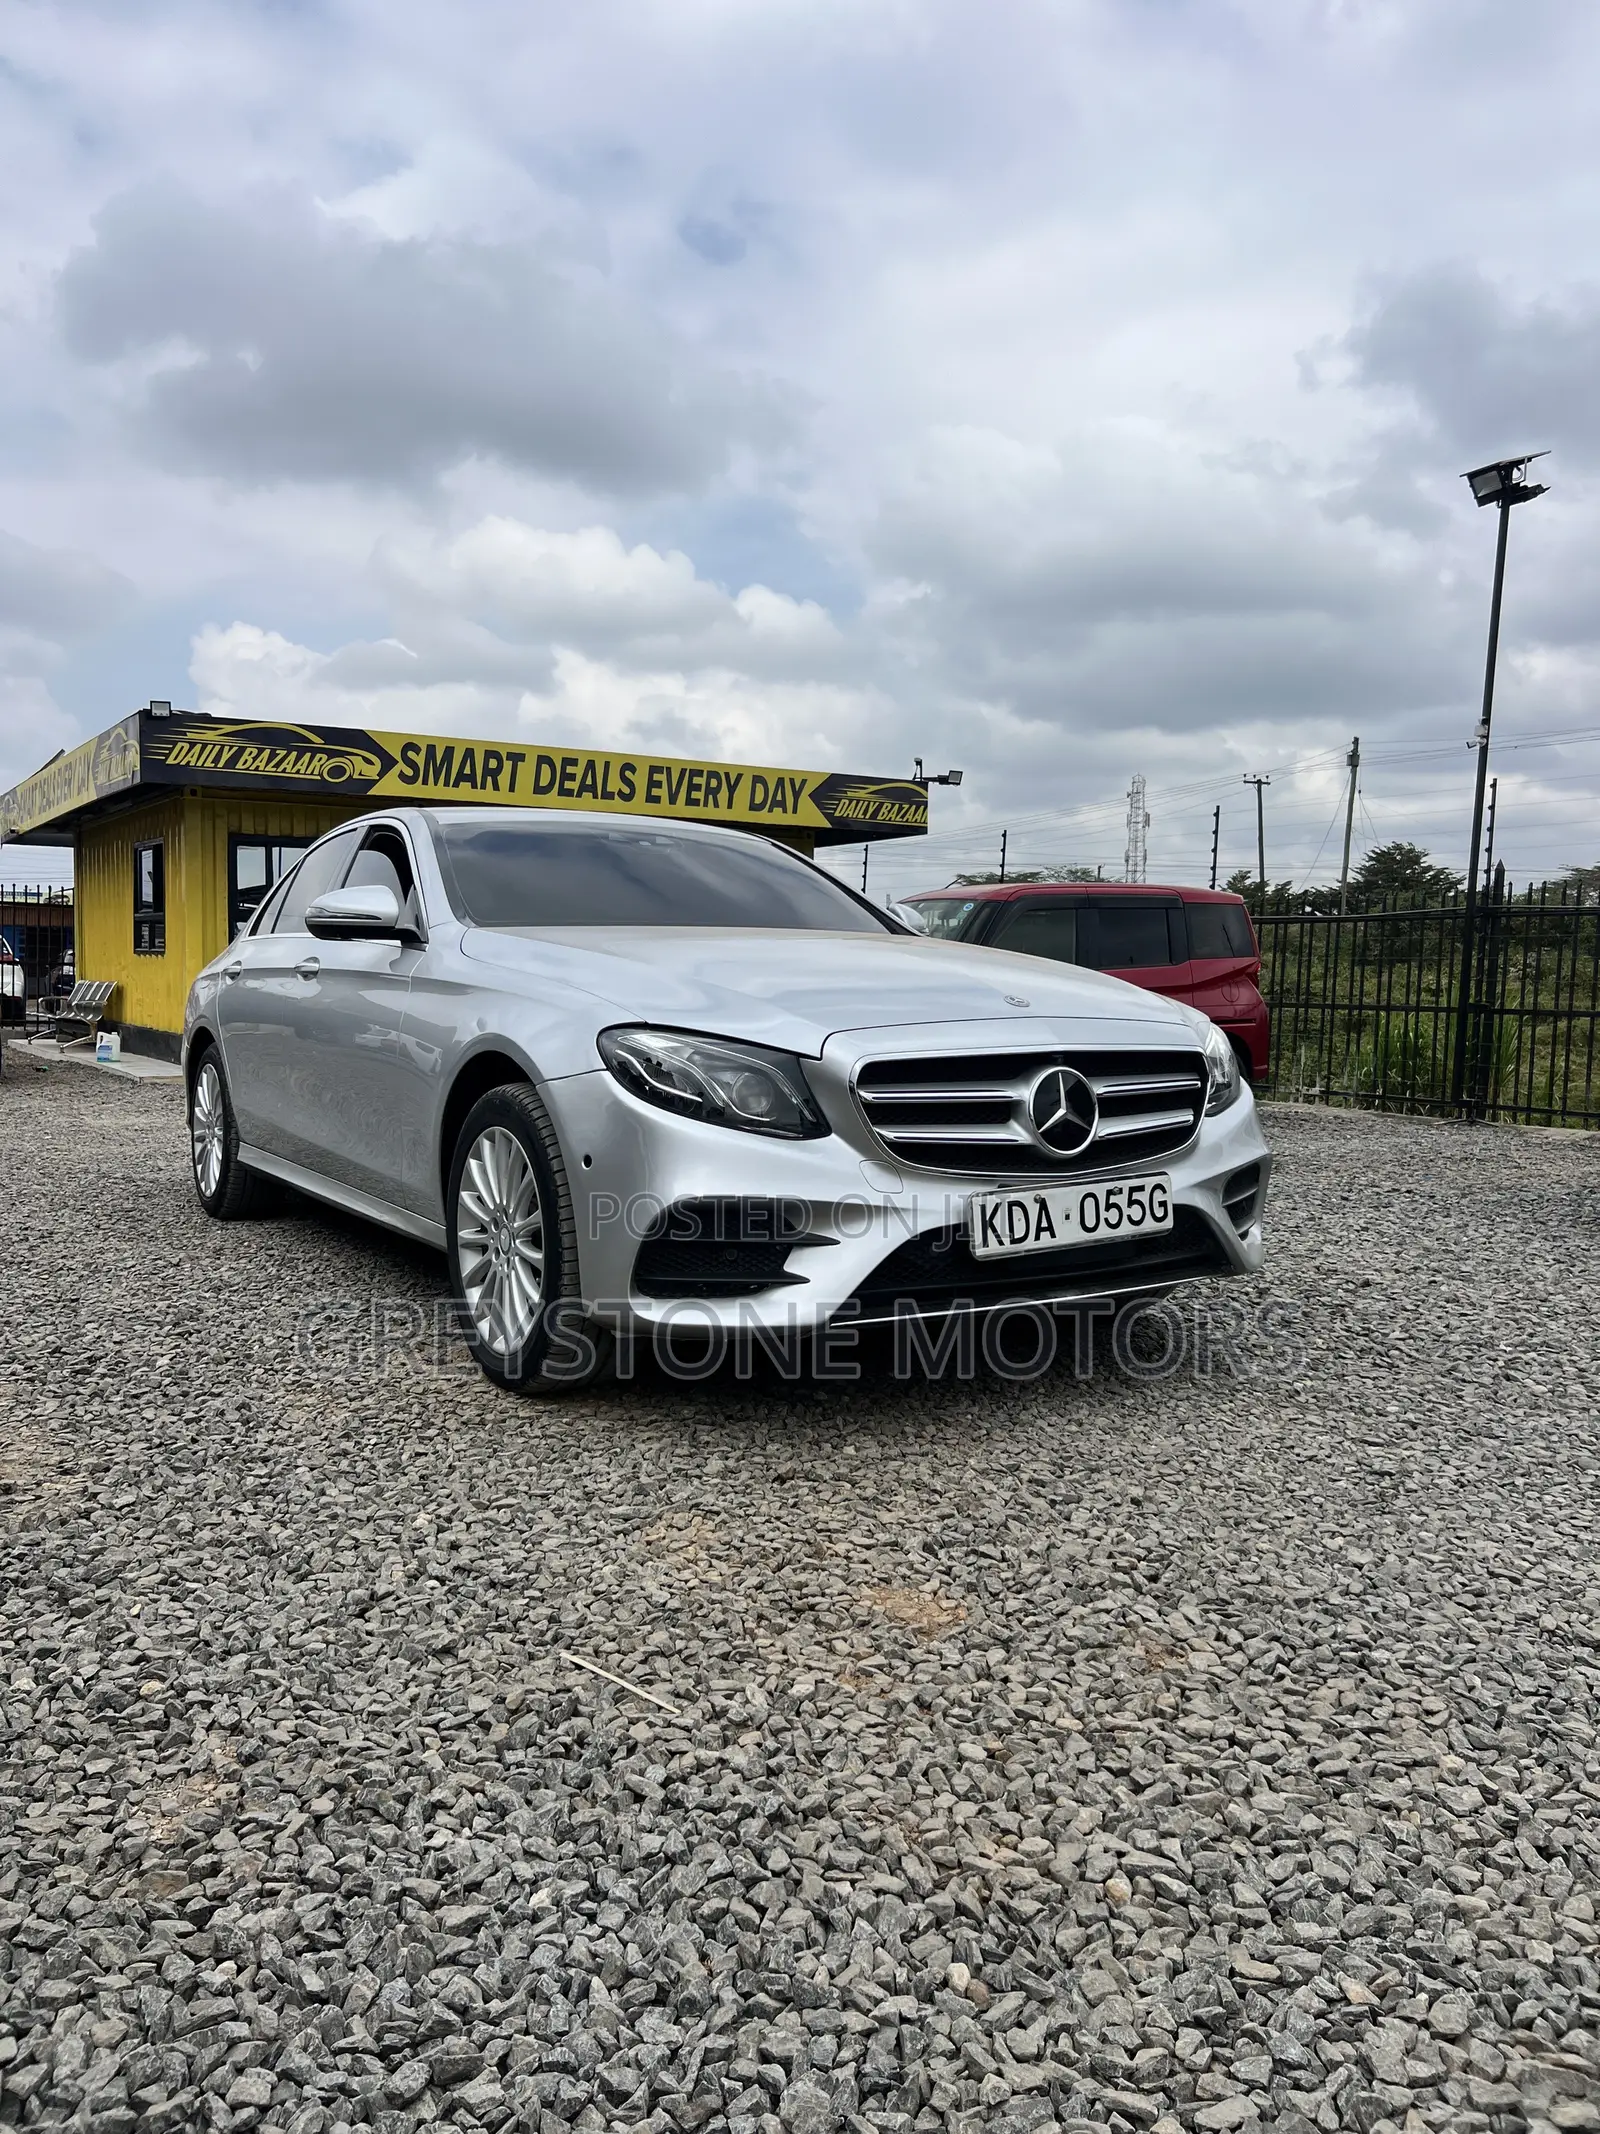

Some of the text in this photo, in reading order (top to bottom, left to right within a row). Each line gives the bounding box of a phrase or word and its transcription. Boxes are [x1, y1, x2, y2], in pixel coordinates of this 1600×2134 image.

[165, 741, 328, 775] DAILY BAZAAR
[397, 741, 808, 815] SMART DEALS EVERY DAY
[834, 798, 880, 820] DAILY
[980, 1197, 1057, 1249] KDA
